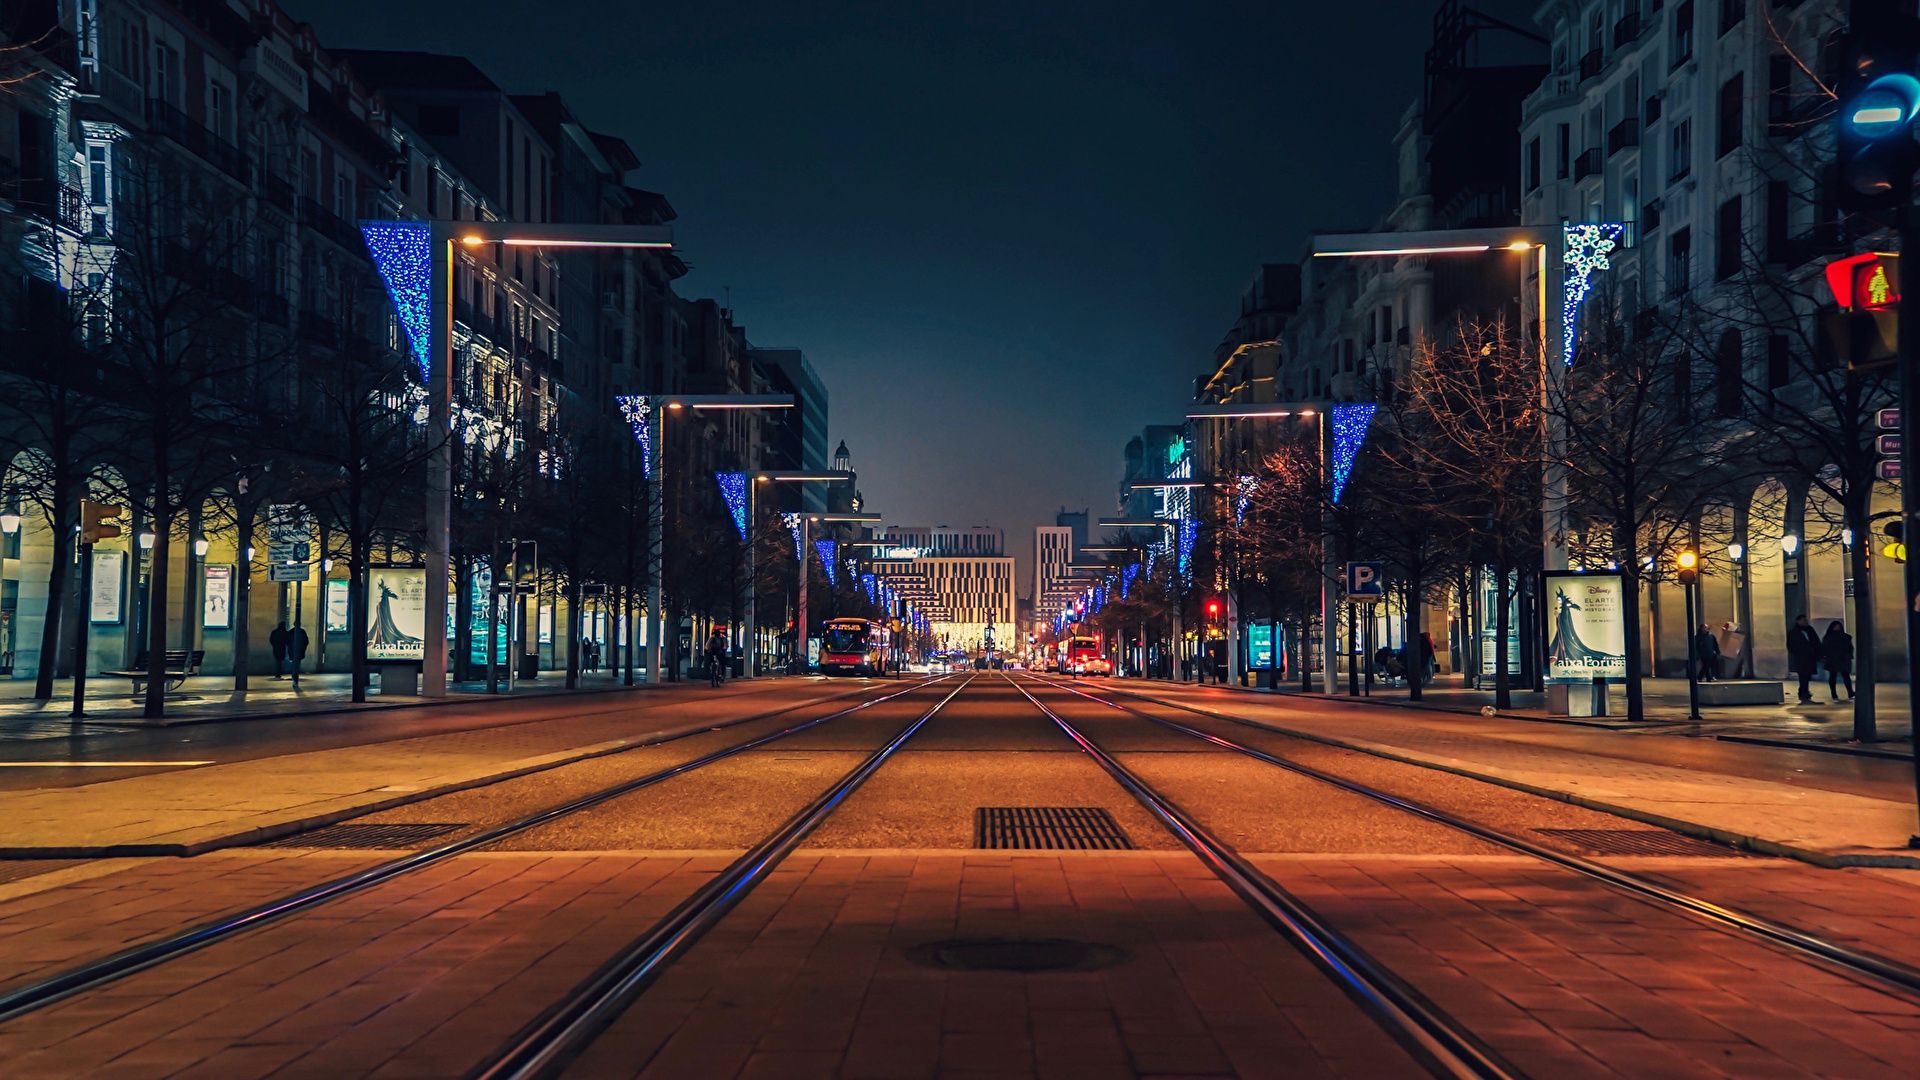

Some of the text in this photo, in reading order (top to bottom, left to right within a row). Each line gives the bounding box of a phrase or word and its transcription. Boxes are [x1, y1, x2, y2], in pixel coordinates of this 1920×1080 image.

[1354, 566, 1374, 591] P
[1586, 585, 1612, 594] Disney
[367, 641, 424, 650] aixaForu
